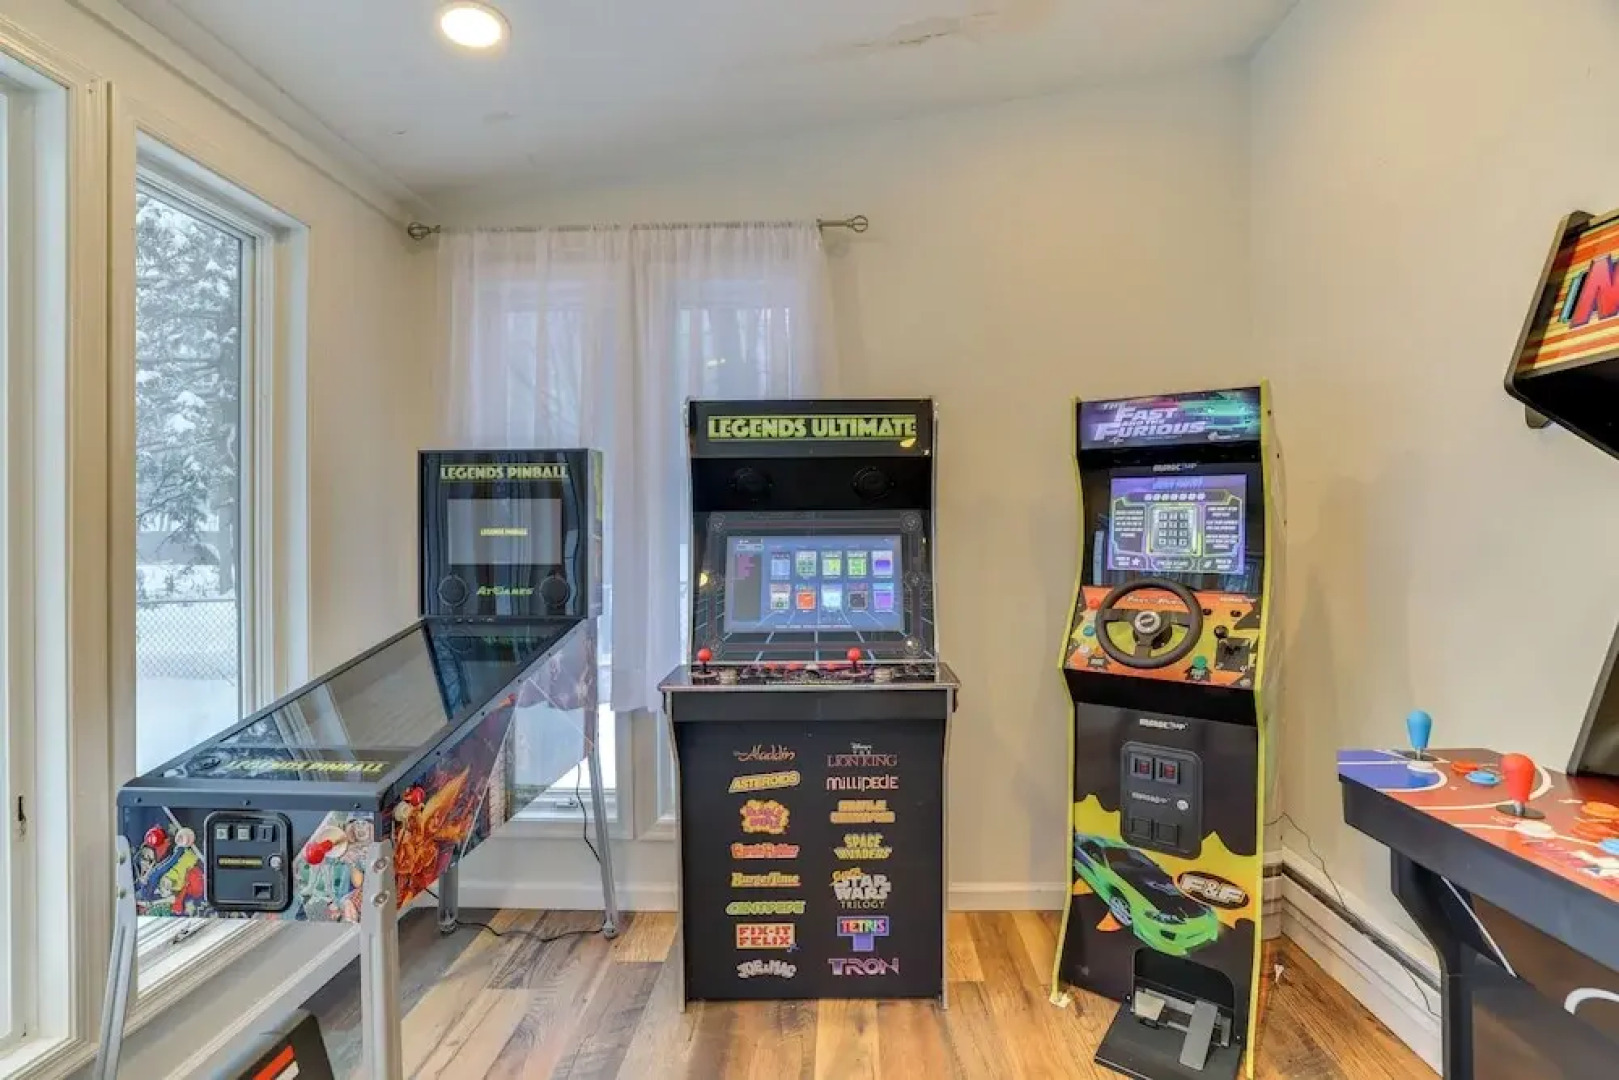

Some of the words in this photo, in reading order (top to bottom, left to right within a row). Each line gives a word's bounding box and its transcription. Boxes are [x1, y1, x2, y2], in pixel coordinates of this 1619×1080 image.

[1114, 406, 1178, 421] FAST
[708, 416, 807, 438] LEGENDS
[811, 415, 917, 438] ULTIMATE
[1093, 421, 1208, 440] FURIOUS
[440, 466, 504, 480] LEGENDS
[507, 465, 569, 478] PINBALL
[861, 754, 898, 767] KING
[843, 833, 884, 847] SPACE
[832, 874, 891, 888] STAR
[834, 886, 892, 900] WARS
[1181, 874, 1246, 903] F&F
[841, 901, 885, 909] TRILOGY
[739, 925, 791, 935] FIX-IT
[841, 919, 886, 933] TETRIS
[739, 936, 791, 946] FELIX
[827, 957, 900, 976] TRON
